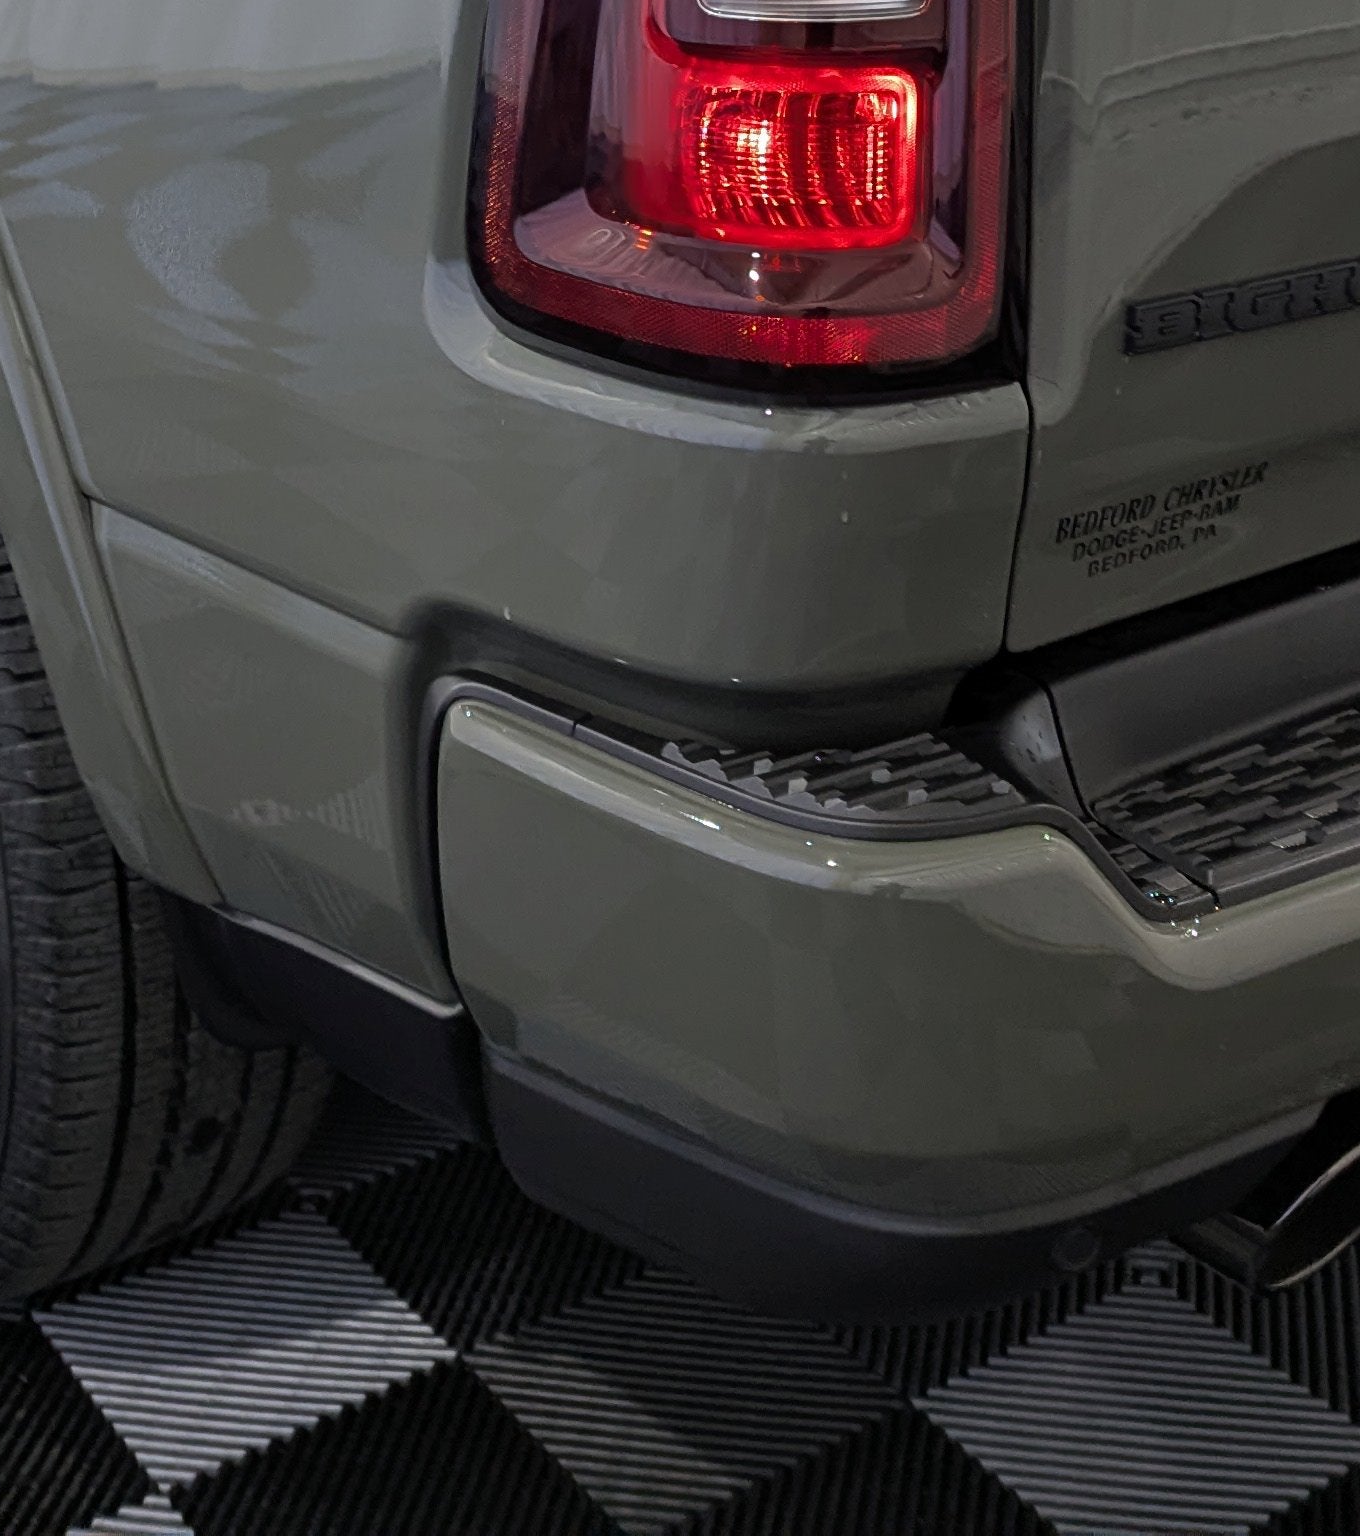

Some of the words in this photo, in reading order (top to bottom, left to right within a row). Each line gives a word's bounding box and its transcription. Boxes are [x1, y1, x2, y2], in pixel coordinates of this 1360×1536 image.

[1055, 493, 1157, 545] BEDFORD
[1163, 460, 1270, 513] CHRYSLER
[1192, 522, 1219, 545] PA
